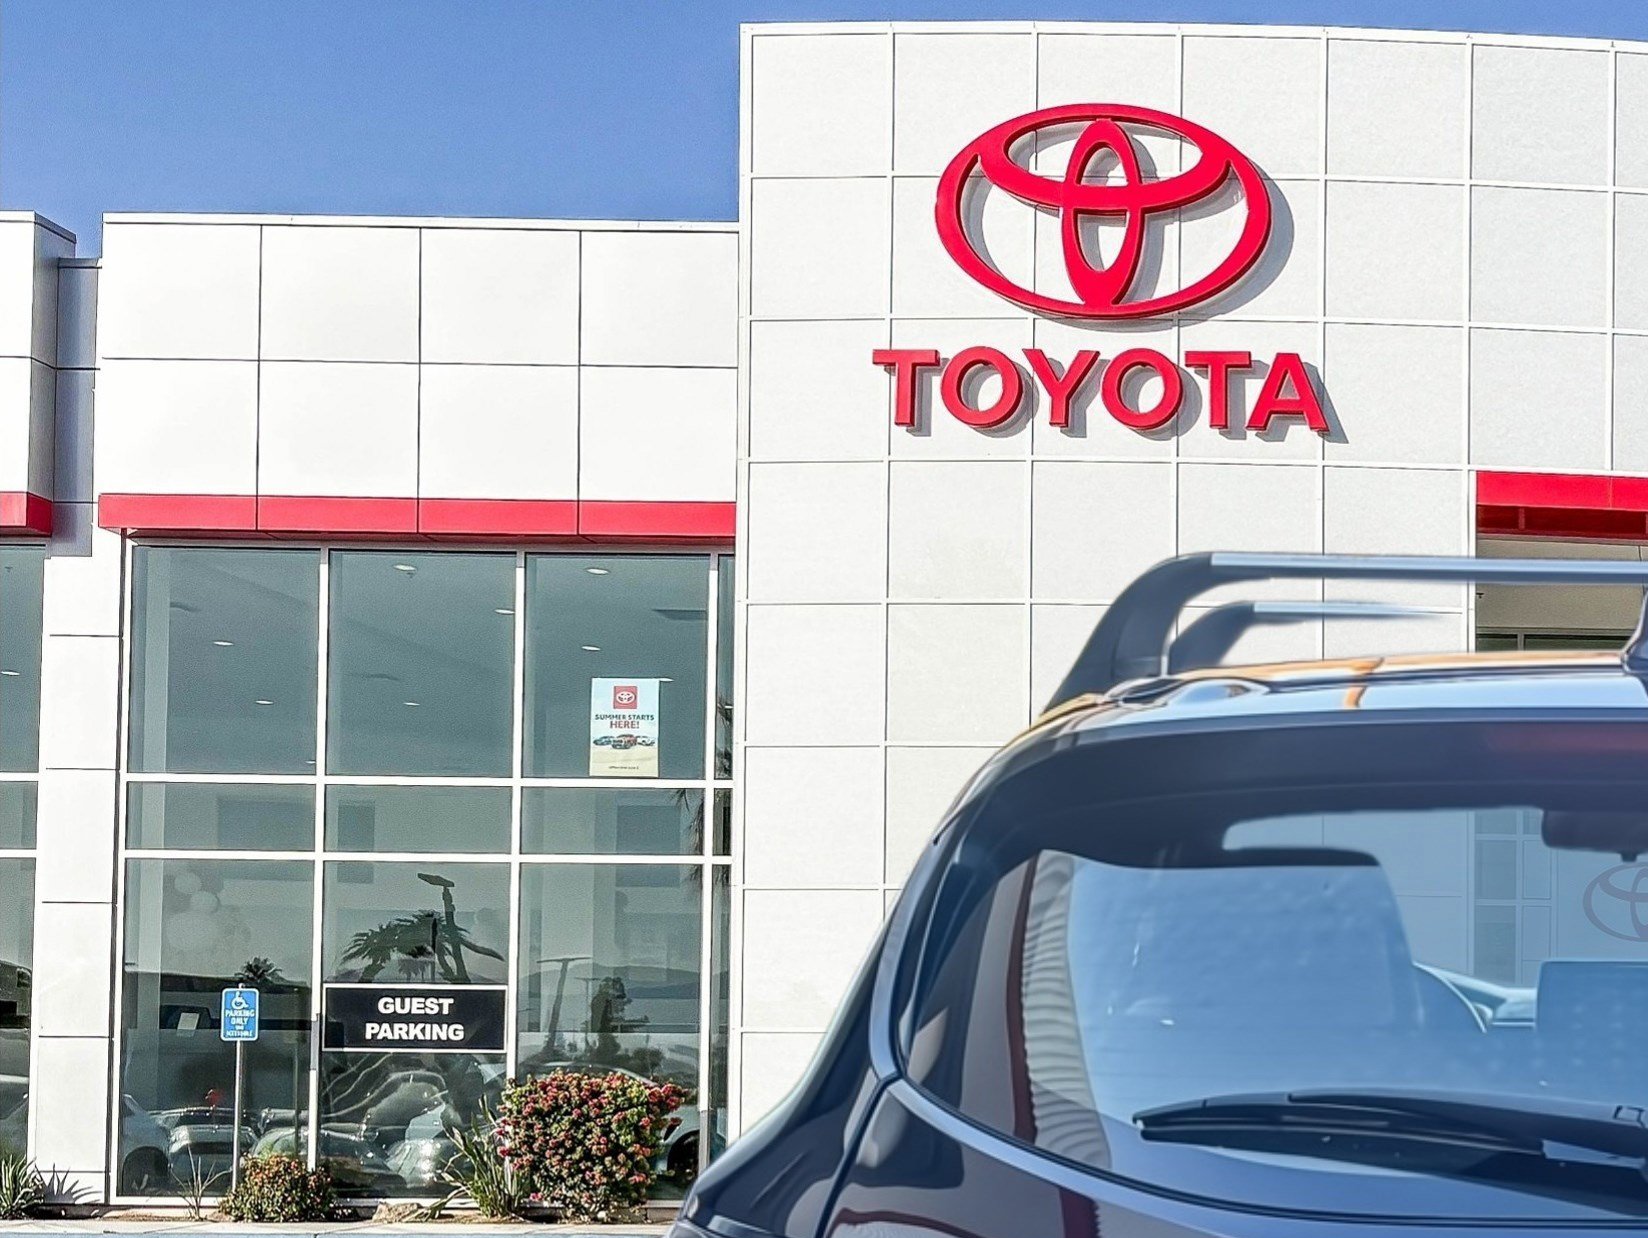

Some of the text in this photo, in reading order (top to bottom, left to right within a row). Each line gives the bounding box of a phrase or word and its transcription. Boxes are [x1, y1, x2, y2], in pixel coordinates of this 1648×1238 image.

[873, 346, 1329, 432] TOYOTA
[609, 721, 640, 729] HERE!
[378, 997, 454, 1015] GUEST
[365, 1022, 464, 1041] PARKING
